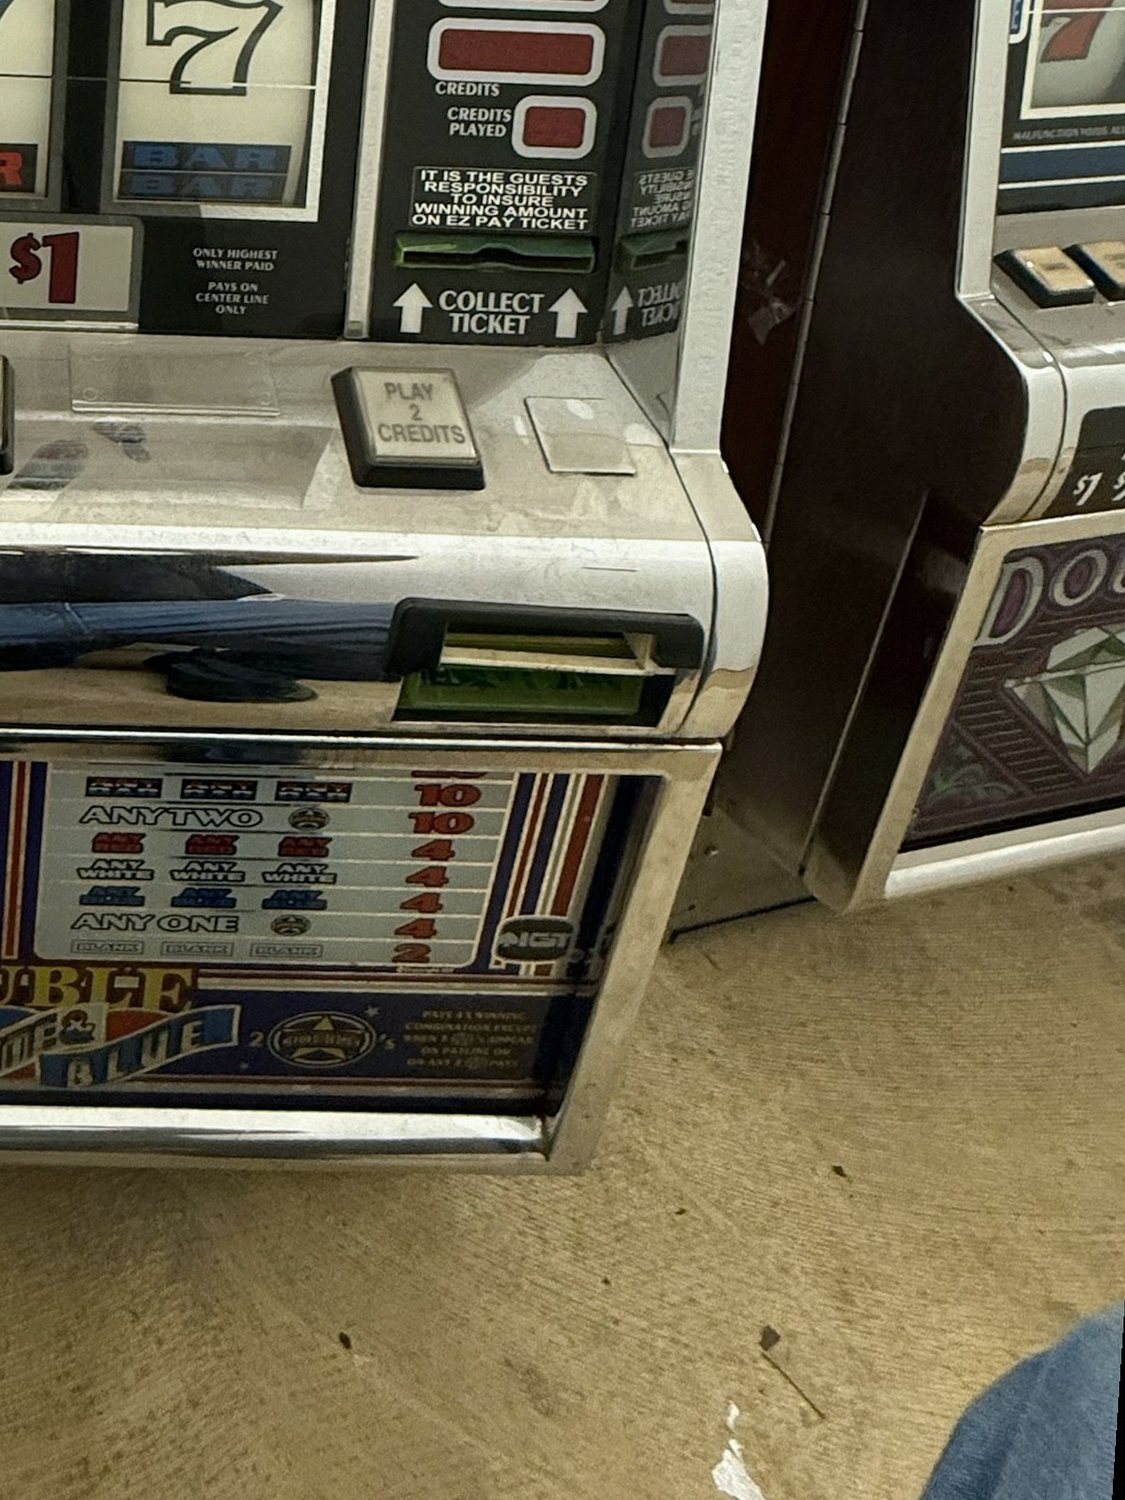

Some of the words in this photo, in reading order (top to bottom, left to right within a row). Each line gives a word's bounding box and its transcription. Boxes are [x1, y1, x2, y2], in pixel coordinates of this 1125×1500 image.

[435, 81, 500, 97] CREDITS
[447, 107, 512, 123] CREDITS
[449, 122, 507, 138] PLAYED
[133, 143, 276, 171] BAR
[421, 169, 438, 181] IT
[443, 170, 462, 182] IS
[467, 171, 504, 183] THE
[509, 172, 588, 186] GUESTS
[425, 181, 583, 197] RESPONSIBILITY
[451, 193, 477, 205] TO
[482, 194, 554, 207] INSURE
[414, 203, 499, 216] WINNING
[504, 205, 588, 219] AMOUNT
[412, 215, 442, 226] ON
[446, 215, 471, 226] EZ
[476, 216, 514, 228] PAY
[518, 217, 588, 230] TICKET
[193, 248, 224, 259] ONLY
[226, 248, 278, 260] HIGHEST
[9, 231, 80, 304] $1
[196, 259, 243, 271] WINNER
[245, 261, 274, 272] PAID
[207, 281, 237, 292] PAYS
[239, 282, 258, 292] ON
[195, 292, 242, 304] CENTER
[243, 294, 270, 304] LINE
[439, 290, 545, 314] COLLECT
[215, 304, 247, 315] ONLY
[449, 313, 530, 335] TICKET
[384, 382, 434, 400] PLAY
[409, 404, 422, 421] 2
[377, 424, 466, 444] CREDITS
[414, 783, 481, 807] 10
[408, 811, 474, 835] 10
[71, 913, 155, 930] ANY
[157, 914, 239, 932] ONE
[395, 918, 437, 939] 4
[61, 1009, 95, 1045] &
[67, 1019, 206, 1088] BLUE
